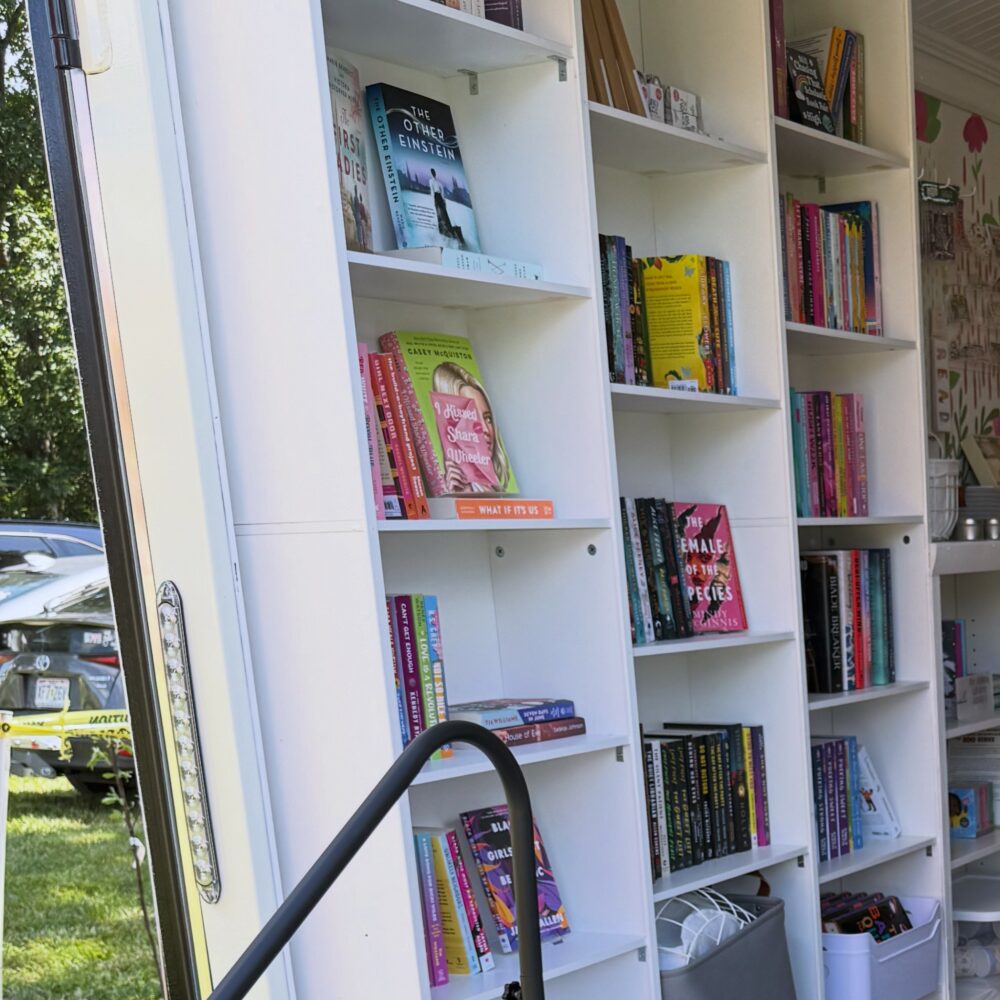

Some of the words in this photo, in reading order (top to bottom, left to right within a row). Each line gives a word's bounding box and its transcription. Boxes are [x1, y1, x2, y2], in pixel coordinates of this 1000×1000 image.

[410, 105, 431, 121] THE
[402, 118, 445, 142] OTHER
[399, 136, 456, 161] EINSTEIN
[337, 151, 367, 186] ADIES
[377, 116, 389, 151] OTHER
[384, 155, 399, 203] EINSTEIN
[407, 348, 431, 356] CASEY
[433, 349, 473, 360] McQUISTON
[374, 359, 383, 382] GIRL
[379, 385, 390, 408] NEXT
[387, 412, 397, 439] DOOR
[434, 402, 441, 413] I
[443, 404, 477, 422] Kissed
[447, 426, 480, 443] Shara
[405, 444, 417, 470] project
[447, 447, 491, 465] Wheeler
[479, 505, 501, 515] WHAT
[504, 505, 511, 514] IF
[514, 505, 526, 514] IT'S
[529, 505, 538, 515] US
[650, 506, 659, 532] ALICE
[686, 516, 703, 527] THE
[654, 533, 663, 564] FEENEY
[681, 538, 724, 553] EMALE
[635, 542, 644, 577] FEENEY
[686, 565, 698, 575] OF
[701, 565, 719, 575] THE
[687, 586, 733, 601] PECIES
[830, 576, 838, 612] BLADE
[400, 603, 409, 625] CAN'T
[402, 626, 411, 640] GET
[831, 616, 841, 670] BREAKER
[405, 642, 414, 673] ENOUGH
[420, 638, 430, 661] LOVE
[409, 692, 418, 724] KENNEDY
[506, 733, 523, 741] House
[524, 729, 530, 738] of
[649, 783, 657, 818] LIBRARIAN
[491, 821, 511, 833] BLA
[487, 847, 513, 861] GIRLS
[461, 873, 469, 888] MUST
[500, 875, 512, 885] BE
[540, 913, 564, 927] ALLEN
